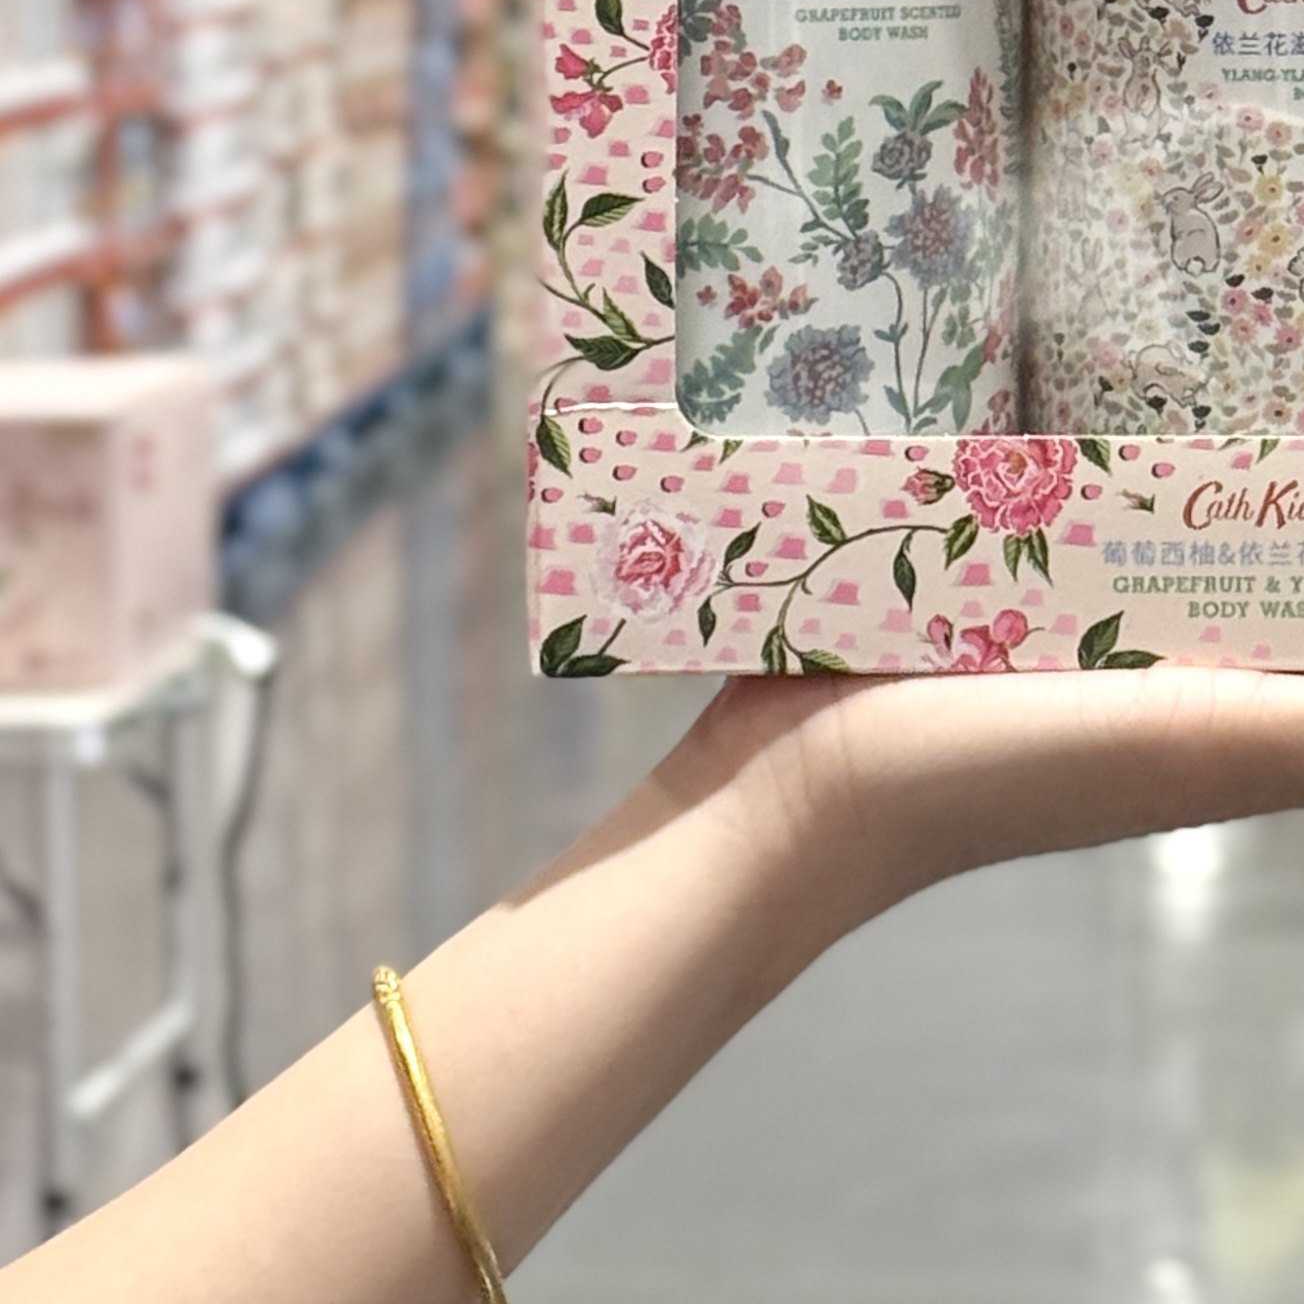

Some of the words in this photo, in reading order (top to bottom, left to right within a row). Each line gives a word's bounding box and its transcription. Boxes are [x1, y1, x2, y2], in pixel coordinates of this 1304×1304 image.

[794, 7, 895, 23] GRAPEFRUIT
[900, 4, 962, 21] SCENTED
[838, 28, 882, 41] BODY
[887, 26, 929, 40] WASH
[1182, 480, 1256, 530] Cath
[1112, 576, 1257, 594] GRAPEFRUIT
[1265, 577, 1281, 593] &
[1188, 602, 1249, 618] BODY
